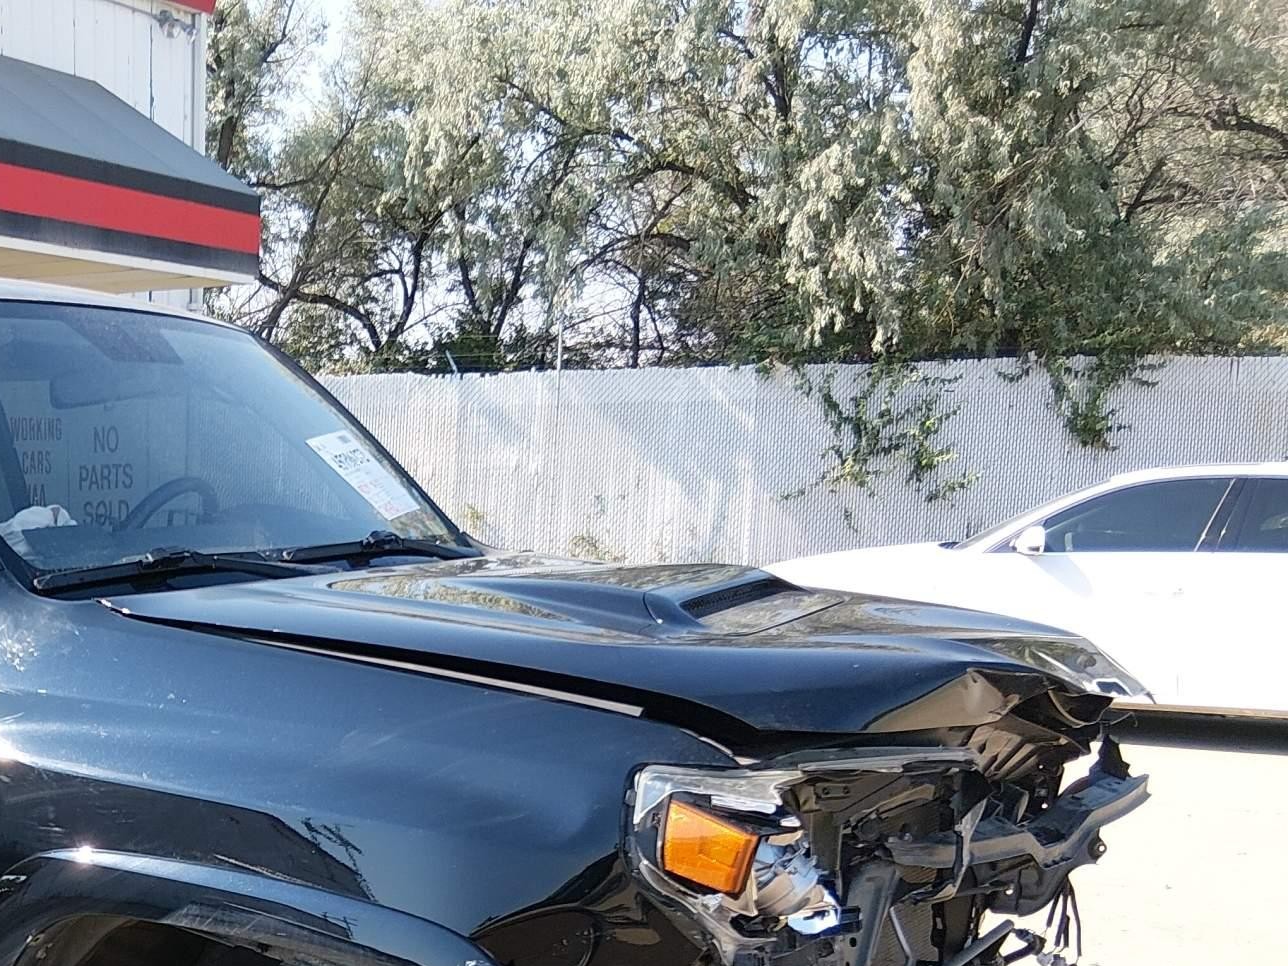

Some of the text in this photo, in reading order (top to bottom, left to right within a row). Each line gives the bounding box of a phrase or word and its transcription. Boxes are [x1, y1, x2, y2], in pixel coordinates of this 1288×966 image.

[10, 416, 62, 441] WORKING
[92, 425, 120, 453] NO
[21, 449, 52, 475] CARS
[78, 462, 134, 491] PARTS
[82, 499, 131, 527] SOLD
